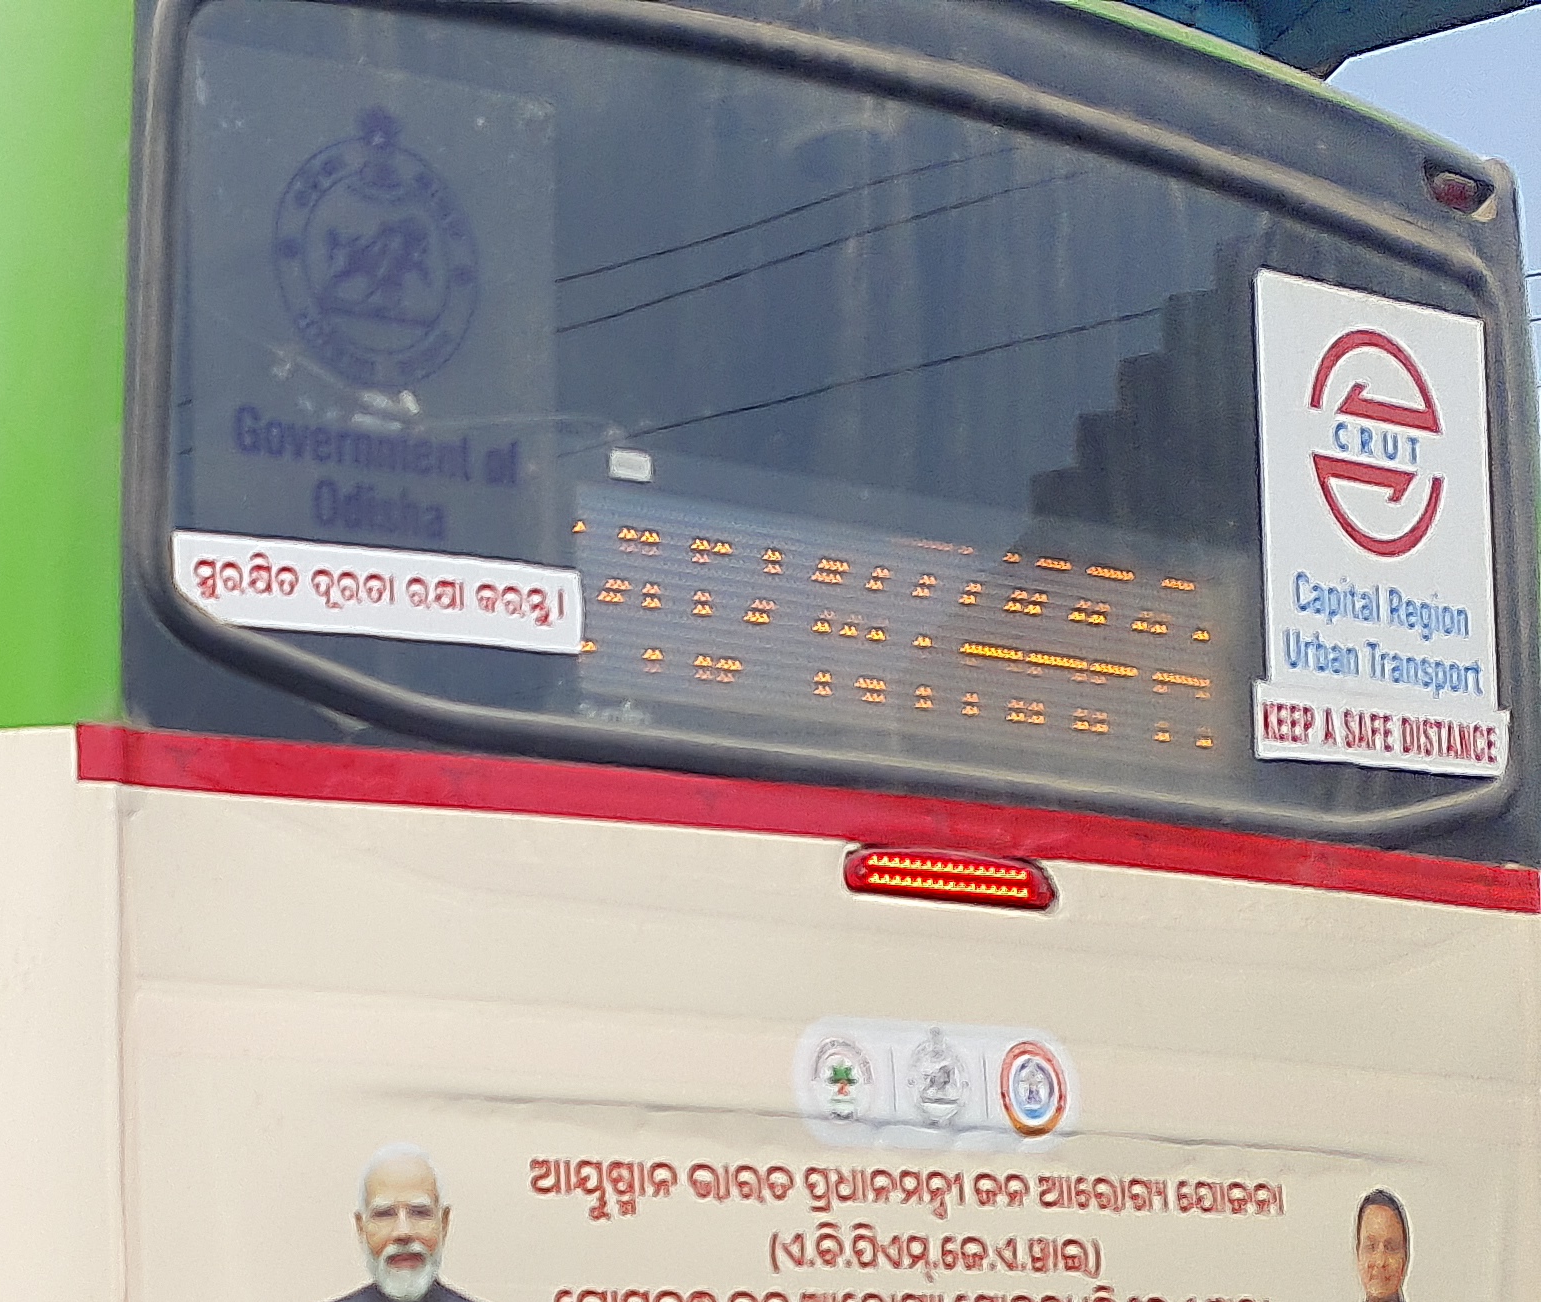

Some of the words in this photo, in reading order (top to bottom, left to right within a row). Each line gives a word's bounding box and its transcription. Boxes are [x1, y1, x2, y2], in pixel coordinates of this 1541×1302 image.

[233, 405, 471, 483] Government
[1334, 421, 1420, 465] CRUT
[315, 479, 447, 540] Odisha
[310, 567, 397, 612] ଦୂରତା
[404, 575, 465, 612] ରକ୍ଷା
[1294, 570, 1381, 624] Capital
[1388, 590, 1469, 642] Region
[1284, 628, 1360, 677] Urban
[1364, 641, 1483, 697] Transport
[1261, 701, 1313, 744] KEEP
[1323, 708, 1336, 746] A
[1345, 708, 1394, 754] SAFE
[1401, 715, 1498, 764] DISTANCE
[687, 1162, 795, 1204] ଭାରତ
[973, 1171, 1031, 1209] ଜନ
[1037, 1175, 1169, 1216] ଆରୋଗ୍ୟ
[1176, 1180, 1286, 1216] ଯୋଜନା
